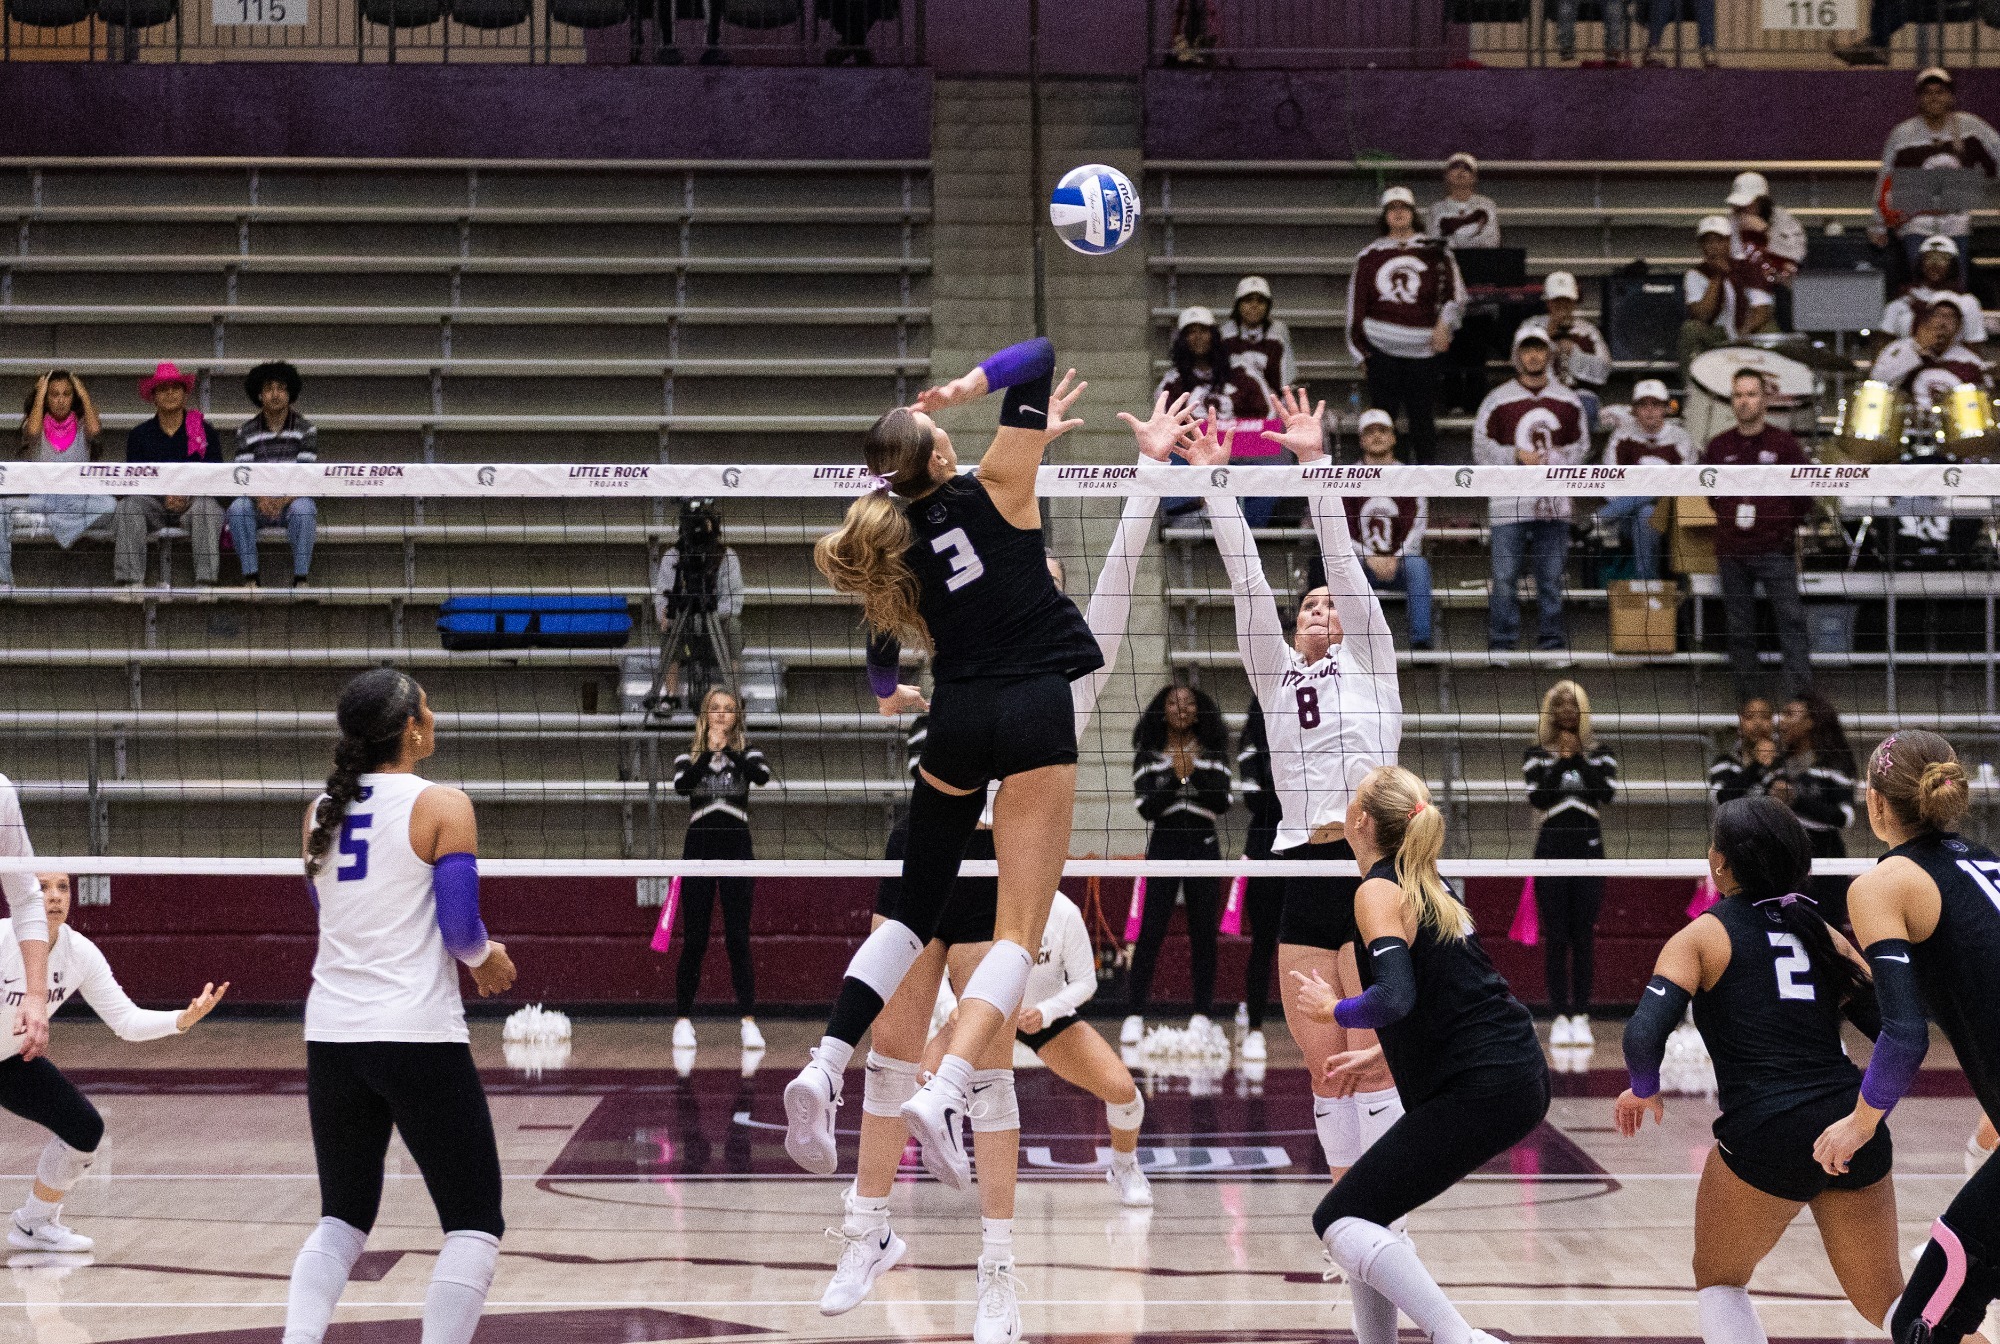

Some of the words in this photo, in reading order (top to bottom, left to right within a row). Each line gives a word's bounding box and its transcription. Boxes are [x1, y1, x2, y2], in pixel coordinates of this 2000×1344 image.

[238, 0, 286, 21] 115
[1787, 1, 1837, 26] 116
[1118, 182, 1134, 232] molten
[80, 466, 121, 476] LITTLE
[125, 466, 160, 476] ROCK
[324, 466, 366, 476] LITTLE
[370, 466, 404, 476] ROCK
[569, 467, 610, 477] LITTLE
[614, 467, 649, 477] ROCK
[813, 468, 855, 478] LITTLE
[1057, 468, 1099, 478] LITTLE
[1102, 468, 1138, 478] ROCK
[1302, 468, 1343, 478] LITTLE
[1347, 468, 1382, 478] ROCK
[1546, 468, 1588, 478] LITTLE
[1591, 468, 1627, 478] ROCK
[1790, 468, 1832, 478] LITTLE
[1834, 468, 1870, 478] ROCK
[929, 526, 984, 592] 3
[1296, 686, 1321, 729] 8
[337, 813, 374, 882] 5
[1766, 932, 1816, 1001] 2
